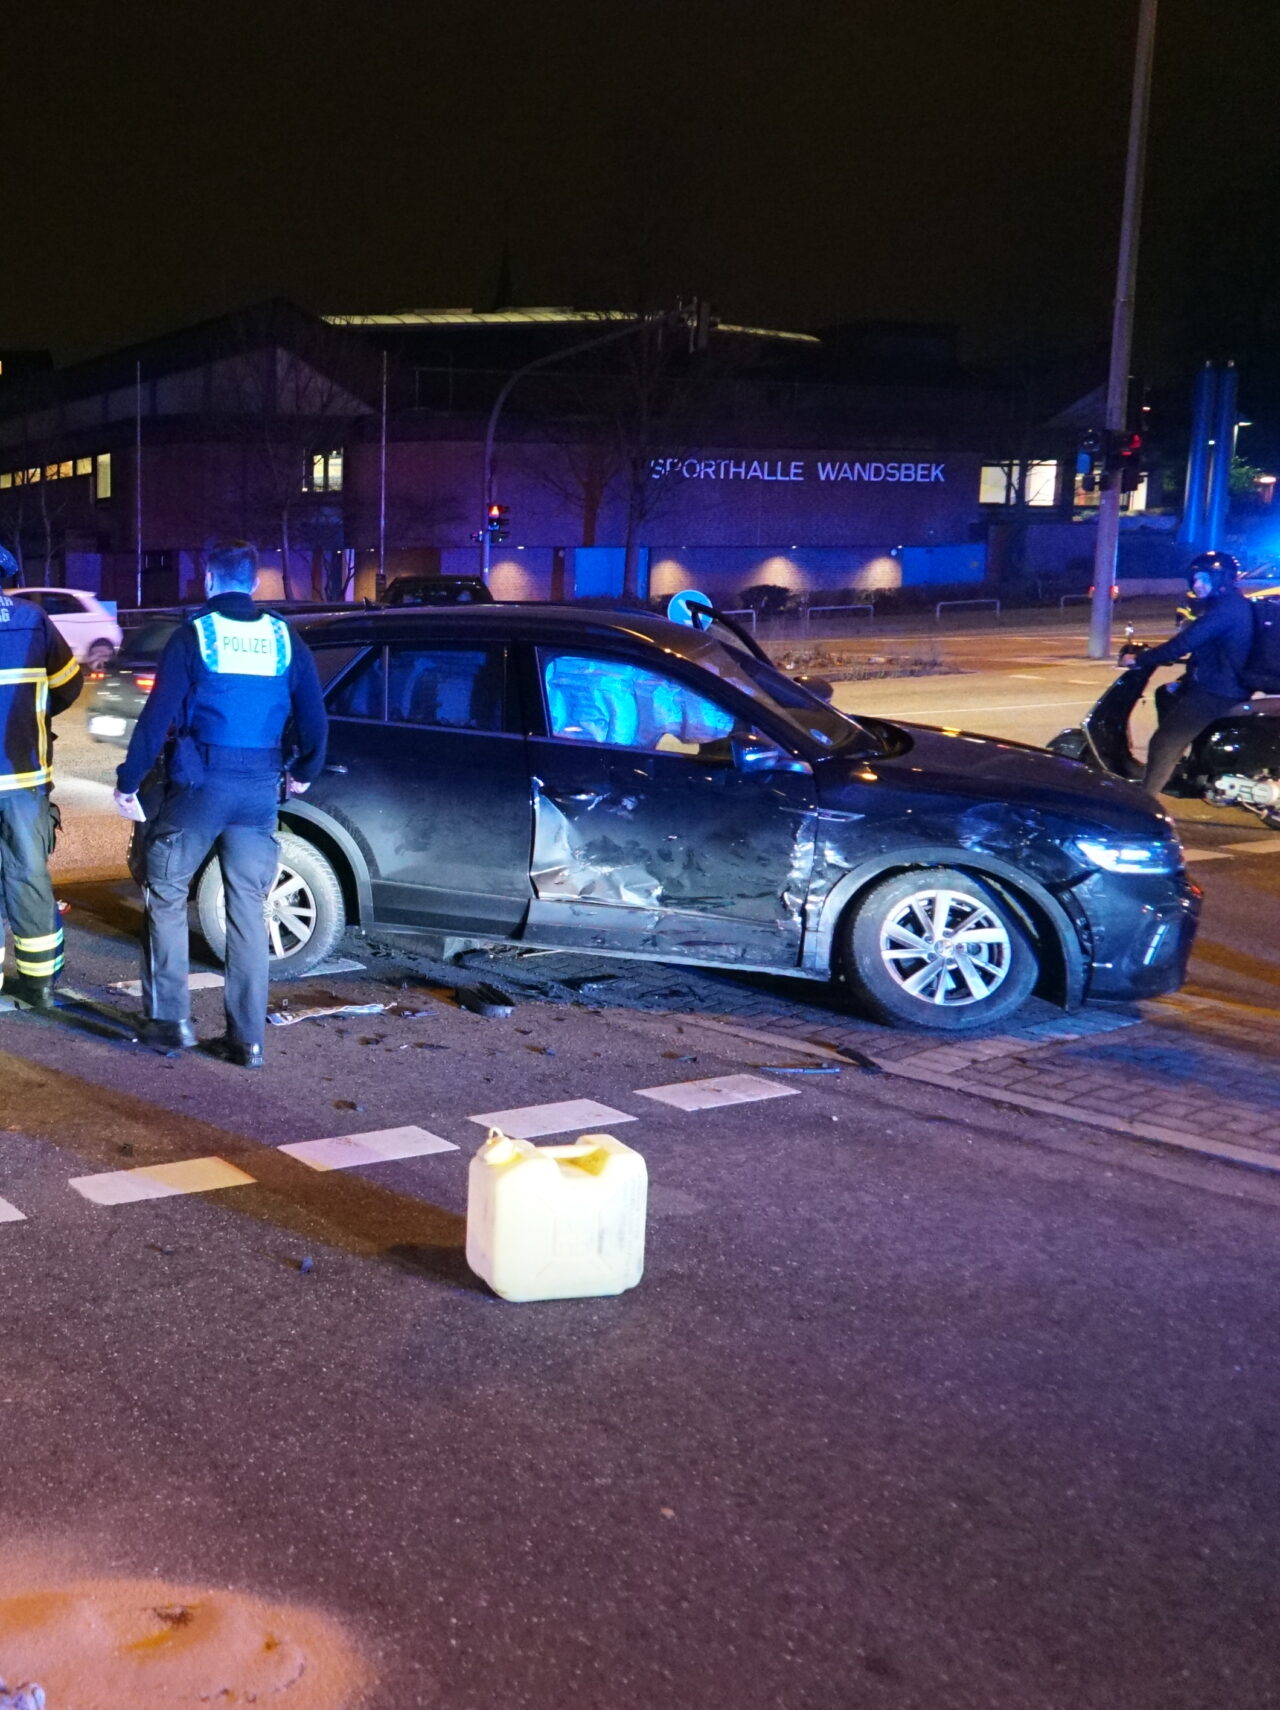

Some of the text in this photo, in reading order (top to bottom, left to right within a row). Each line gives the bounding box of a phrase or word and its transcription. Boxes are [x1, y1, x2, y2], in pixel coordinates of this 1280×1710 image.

[650, 458, 946, 483] SPORTHALLE WANDSBEK
[223, 635, 273, 655] POLIZEI
